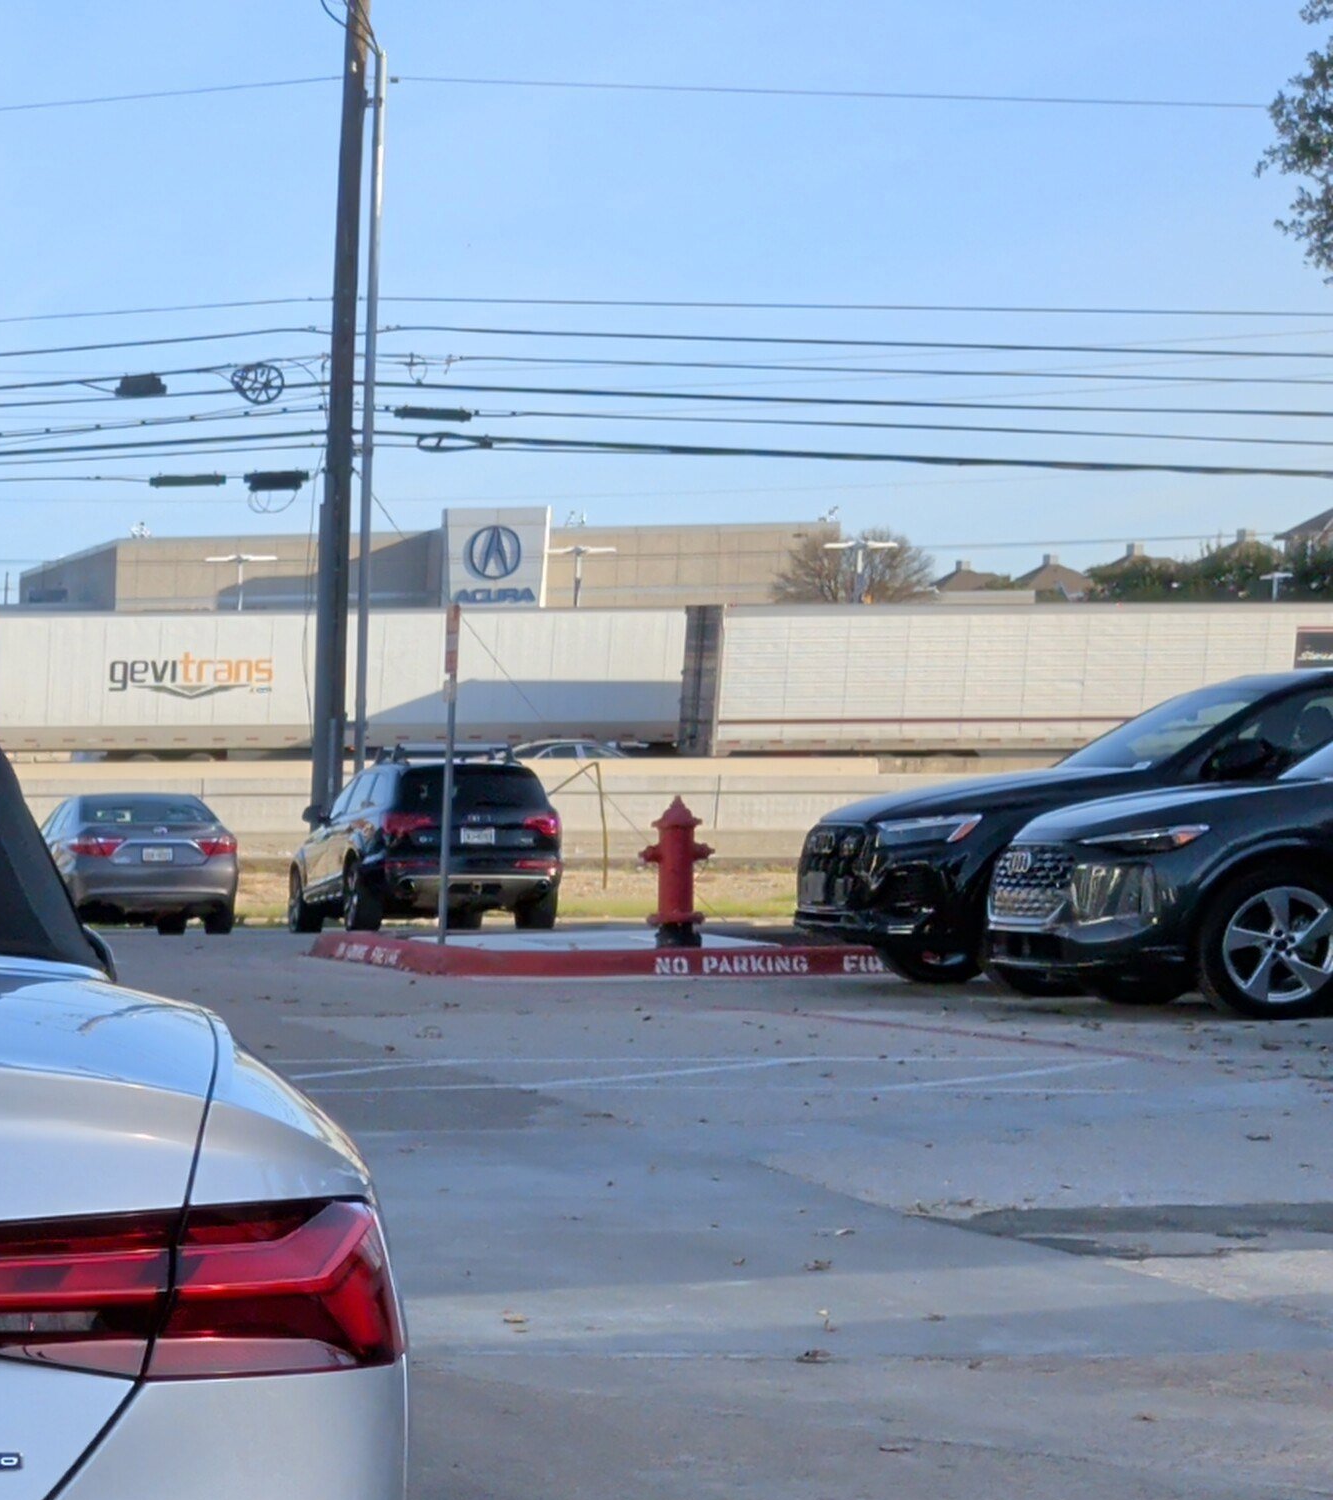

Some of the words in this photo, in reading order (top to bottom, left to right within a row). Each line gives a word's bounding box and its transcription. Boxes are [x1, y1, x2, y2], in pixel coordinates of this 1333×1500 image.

[454, 587, 537, 603] ACURA
[108, 651, 274, 692] gevitrans
[654, 957, 689, 975] NO
[701, 955, 809, 975] PARKING
